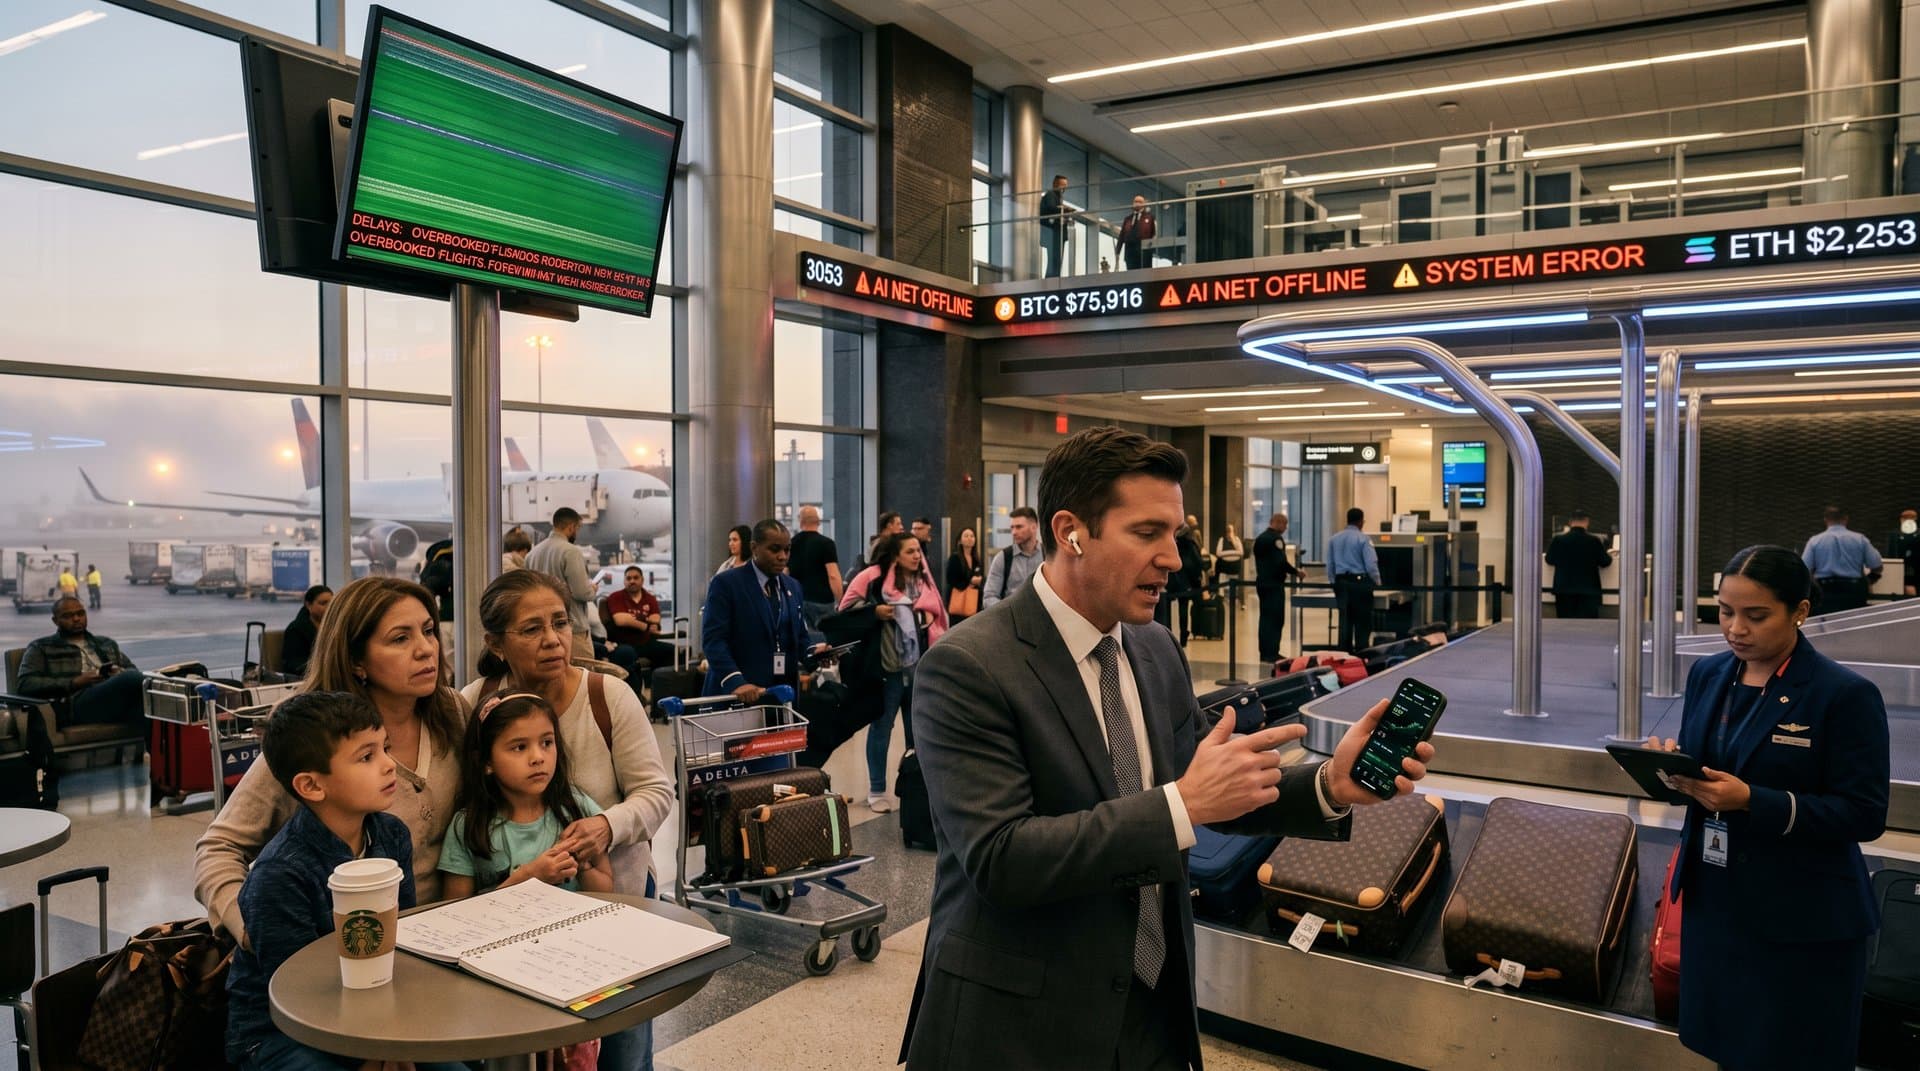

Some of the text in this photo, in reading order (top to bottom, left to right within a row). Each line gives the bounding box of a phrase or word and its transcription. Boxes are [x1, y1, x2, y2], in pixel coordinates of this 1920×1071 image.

[350, 230, 436, 258] OVERBOOKED
[352, 213, 403, 235] DELAYS:
[411, 227, 490, 253] OVERBOOKED
[806, 258, 973, 318] 3053 AI NET OFFLINE
[1020, 219, 1917, 318] BTC $75,916 AI NET OFFLINE SYSTEM ERROR ETH $2,253
[706, 766, 748, 782] DELTA
